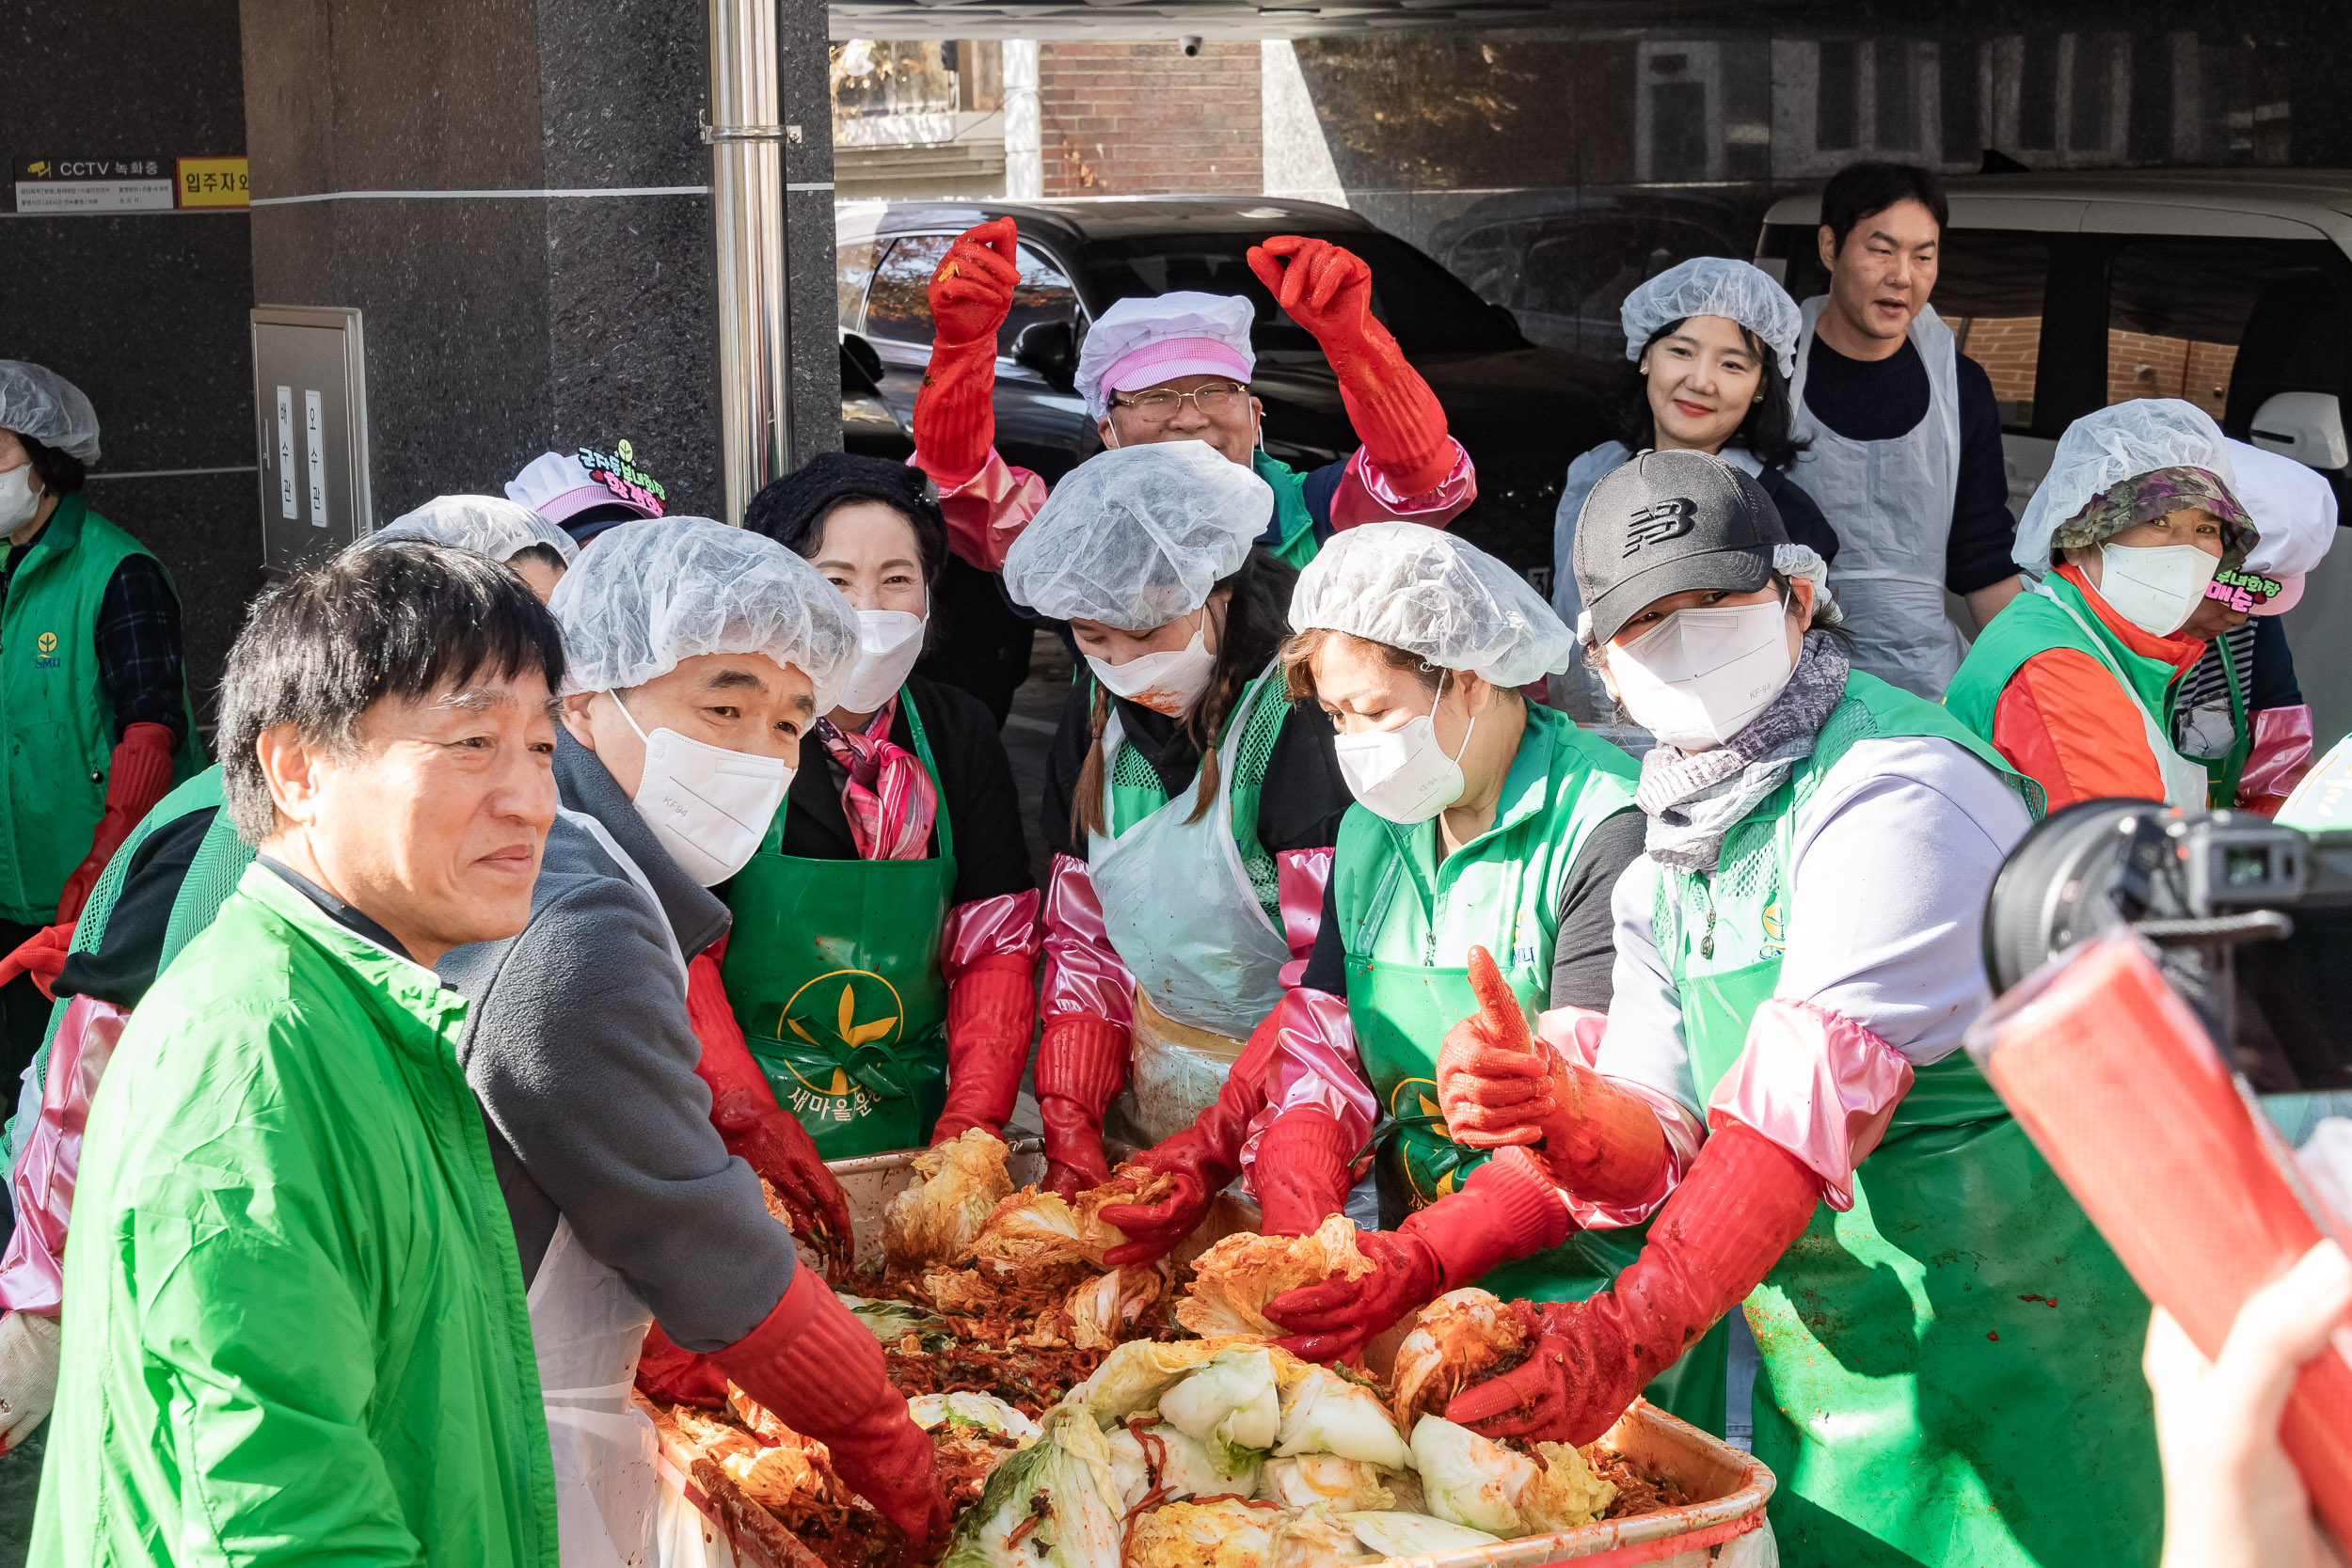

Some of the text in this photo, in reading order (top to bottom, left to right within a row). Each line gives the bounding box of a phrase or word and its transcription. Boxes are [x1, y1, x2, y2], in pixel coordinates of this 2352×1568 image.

[60, 161, 159, 177] CCTV 녹화중
[579, 447, 622, 477] 군자동
[34, 657, 61, 669] SMU
[662, 796, 689, 818] KF94
